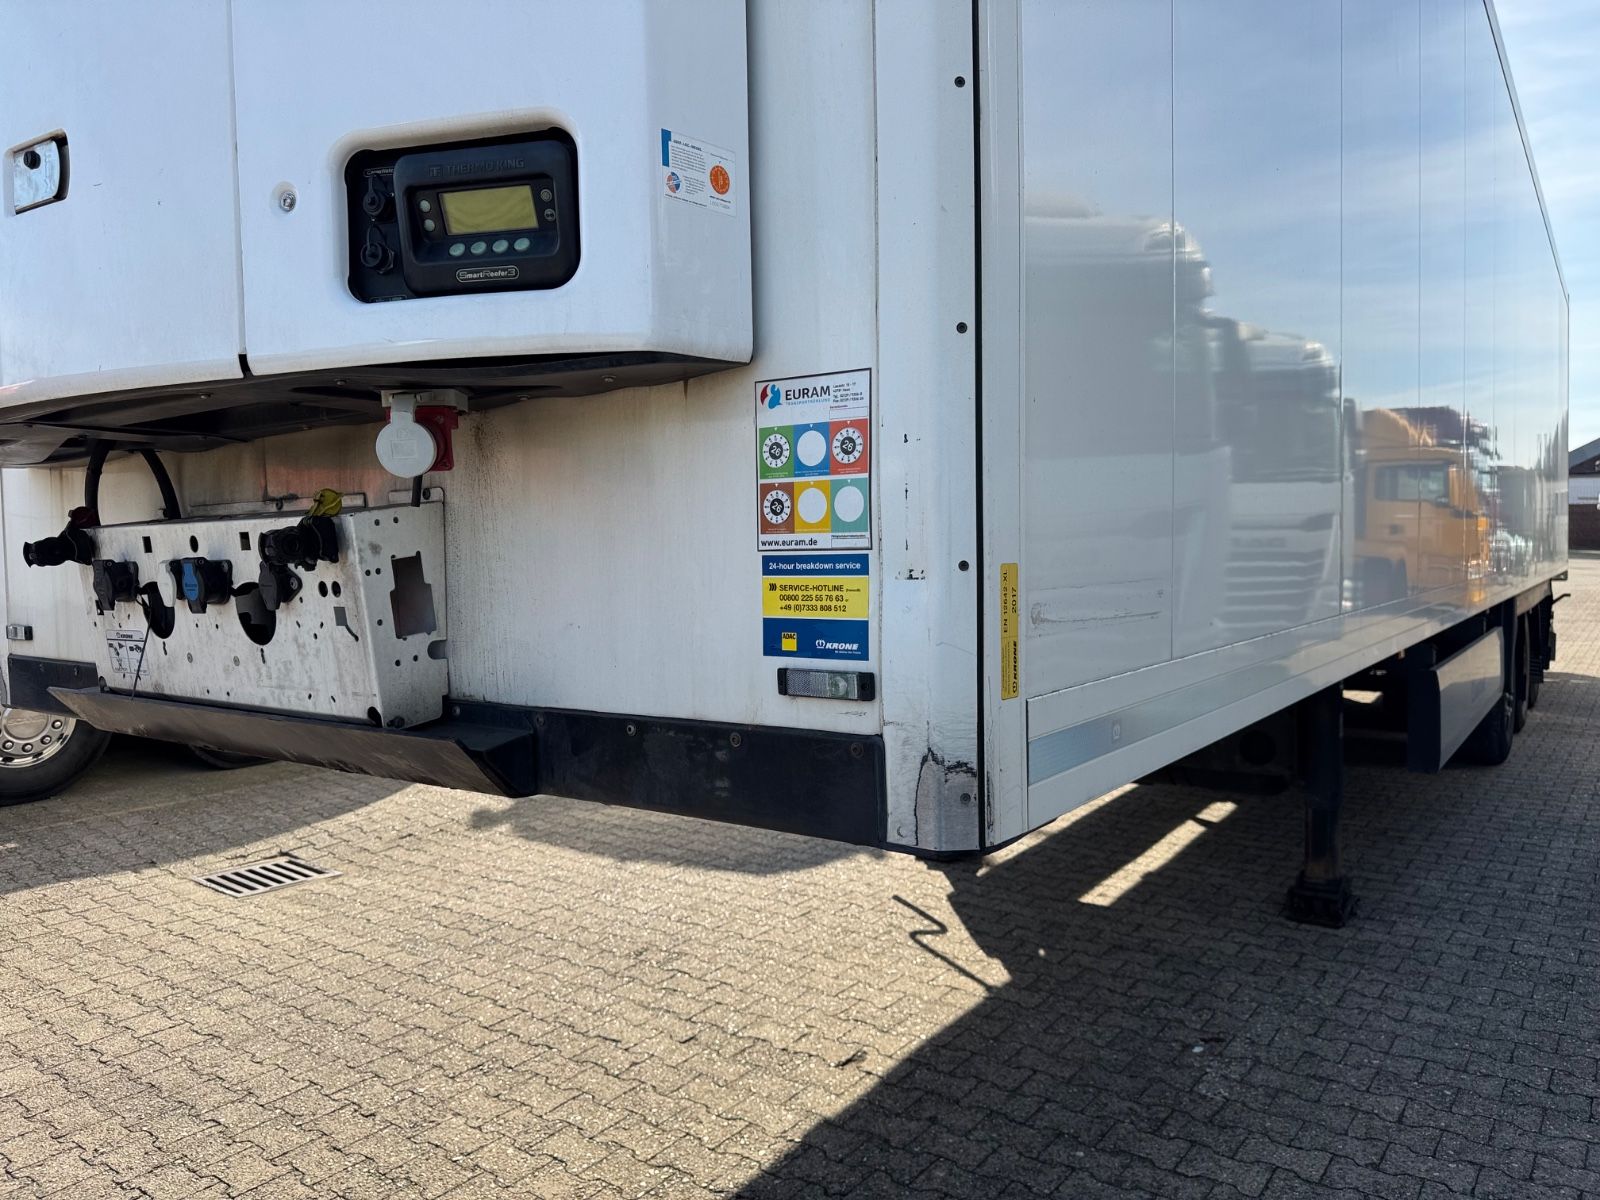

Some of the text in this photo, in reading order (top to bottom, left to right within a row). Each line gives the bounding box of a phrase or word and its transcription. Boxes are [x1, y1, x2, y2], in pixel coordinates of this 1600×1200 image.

[498, 158, 525, 169] KING
[785, 385, 831, 401] EURAM
[771, 445, 781, 457] 26
[842, 440, 853, 451] 26
[771, 501, 782, 513] 26
[761, 538, 818, 547] www.euram.de
[795, 562, 833, 570] breakdown
[835, 562, 861, 570] service
[779, 594, 799, 602] 00800
[801, 594, 814, 602] 225
